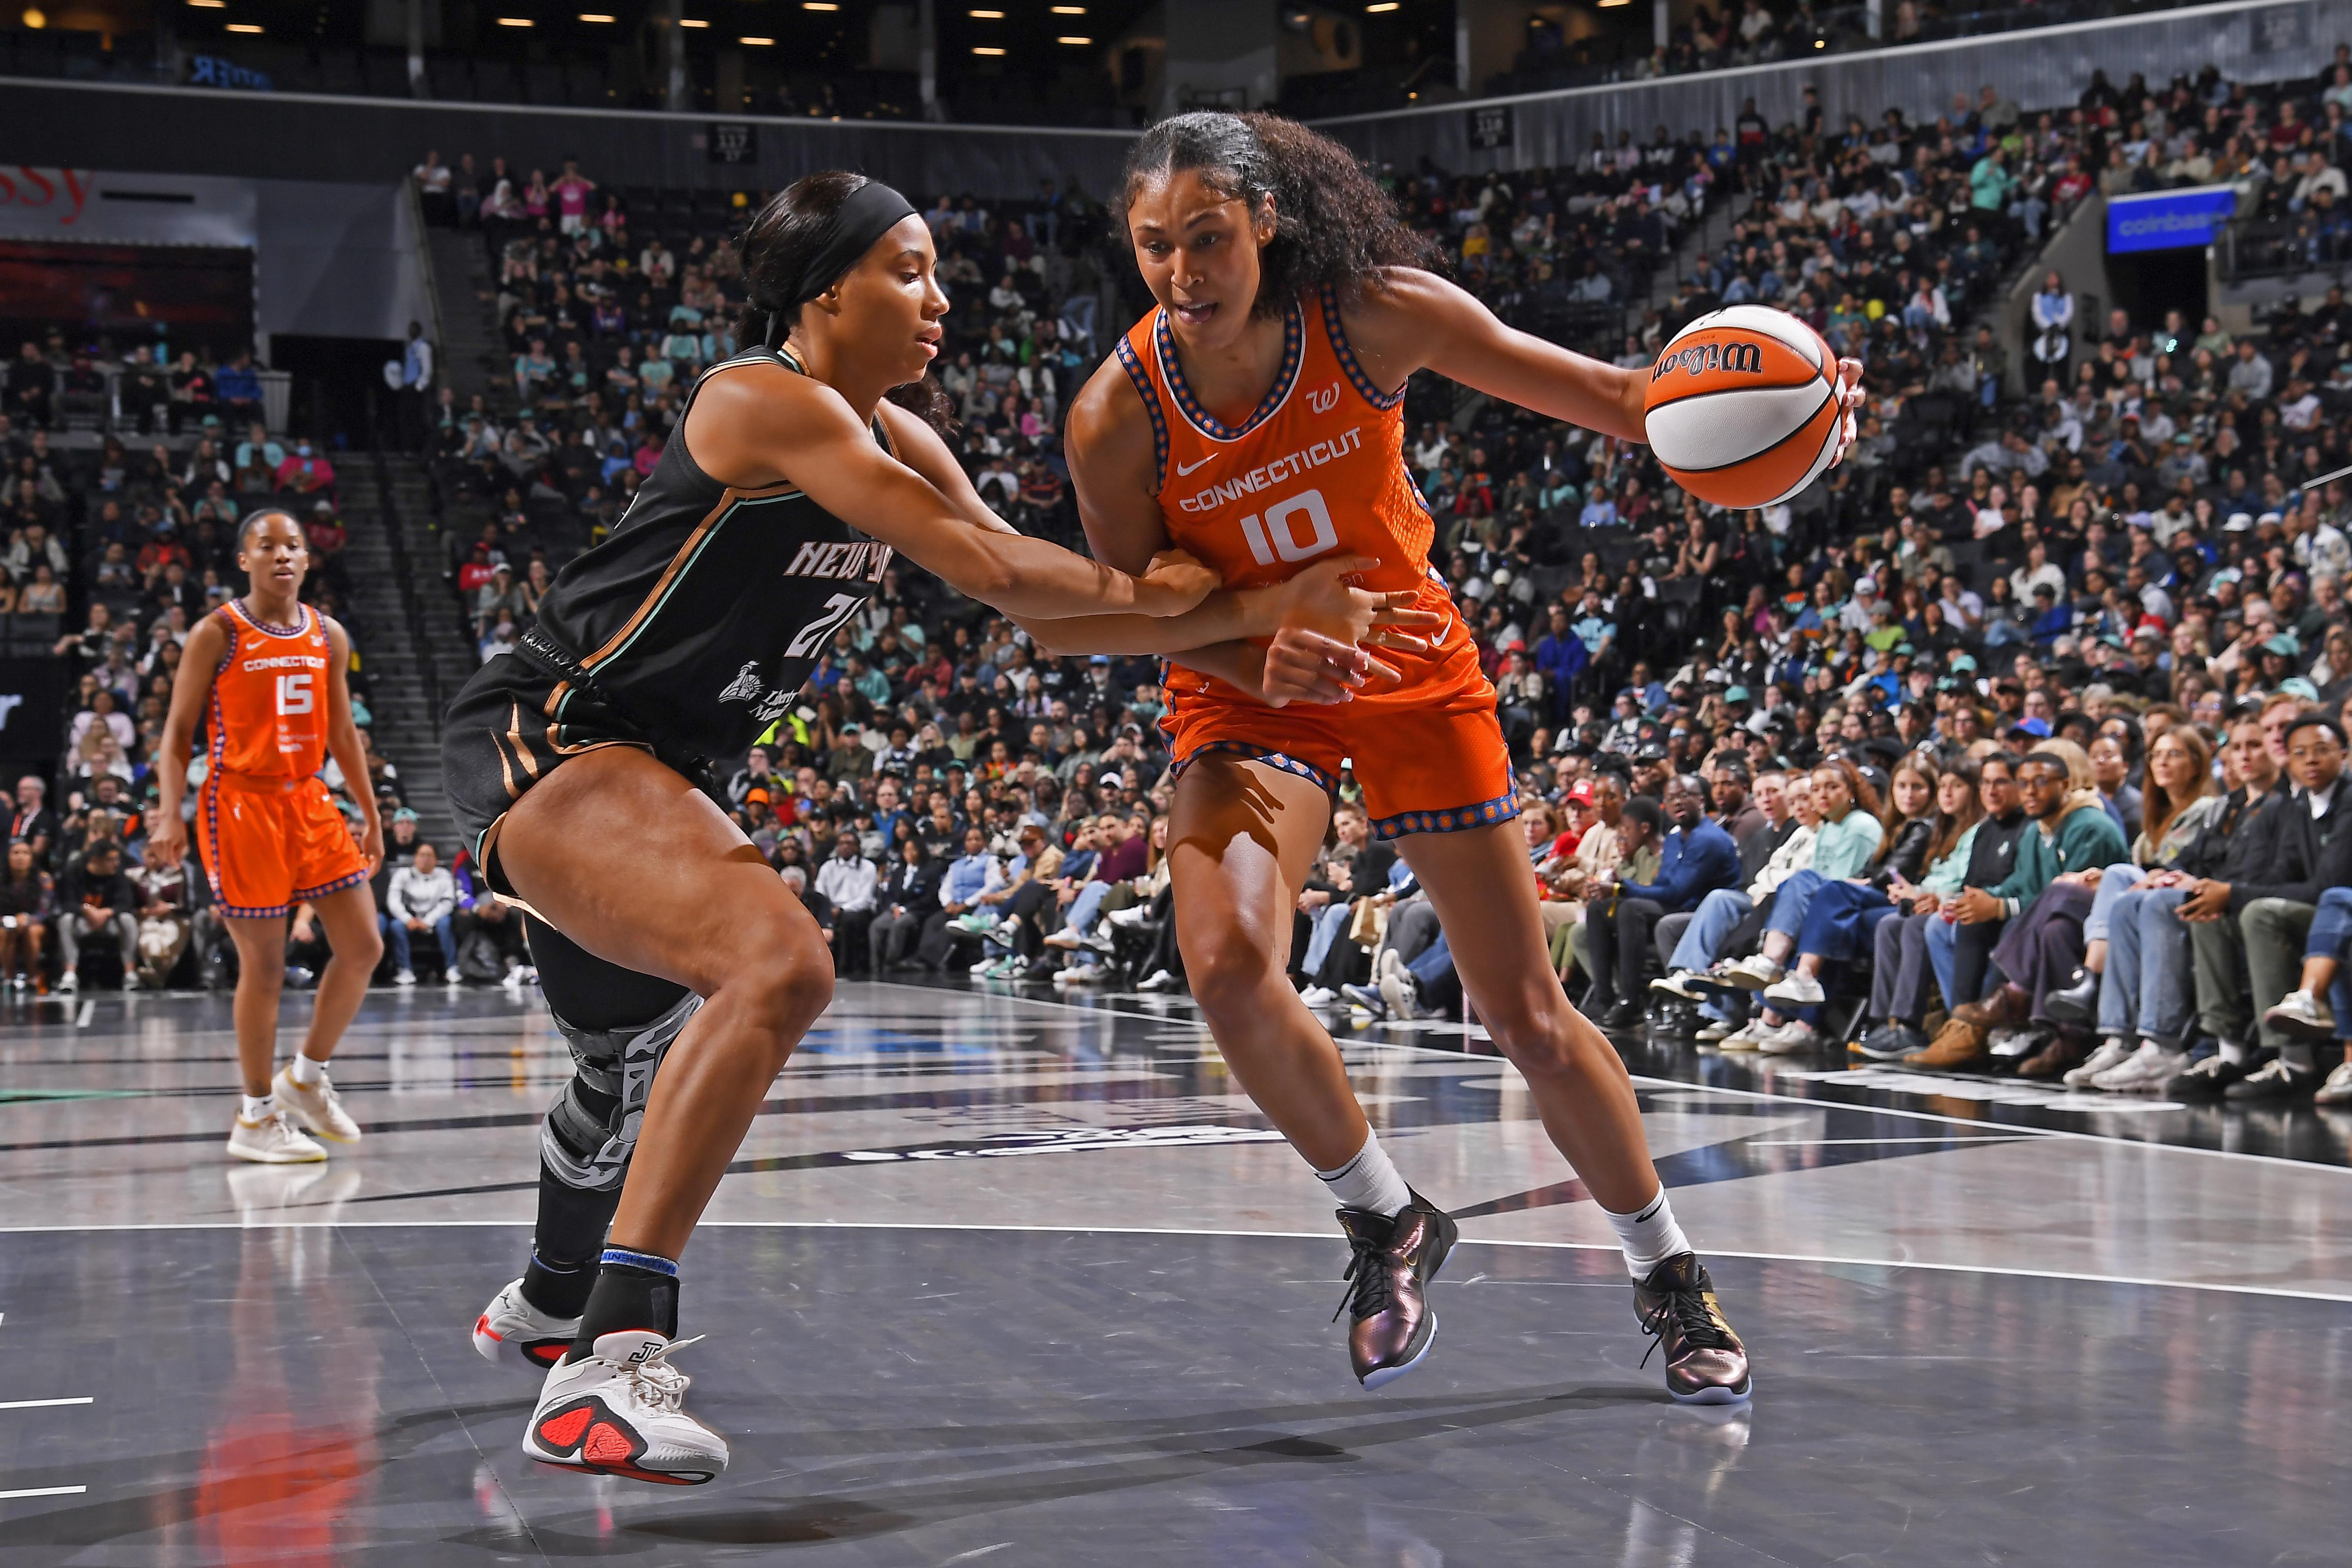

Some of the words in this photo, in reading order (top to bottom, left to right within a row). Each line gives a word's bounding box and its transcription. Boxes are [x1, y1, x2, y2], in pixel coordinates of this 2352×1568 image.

[1651, 342, 1763, 384] Wilson
[1179, 427, 1361, 512] CONNECTICUT
[1240, 489, 1339, 566] 10
[783, 541, 870, 580] NEW
[276, 674, 313, 716] 15
